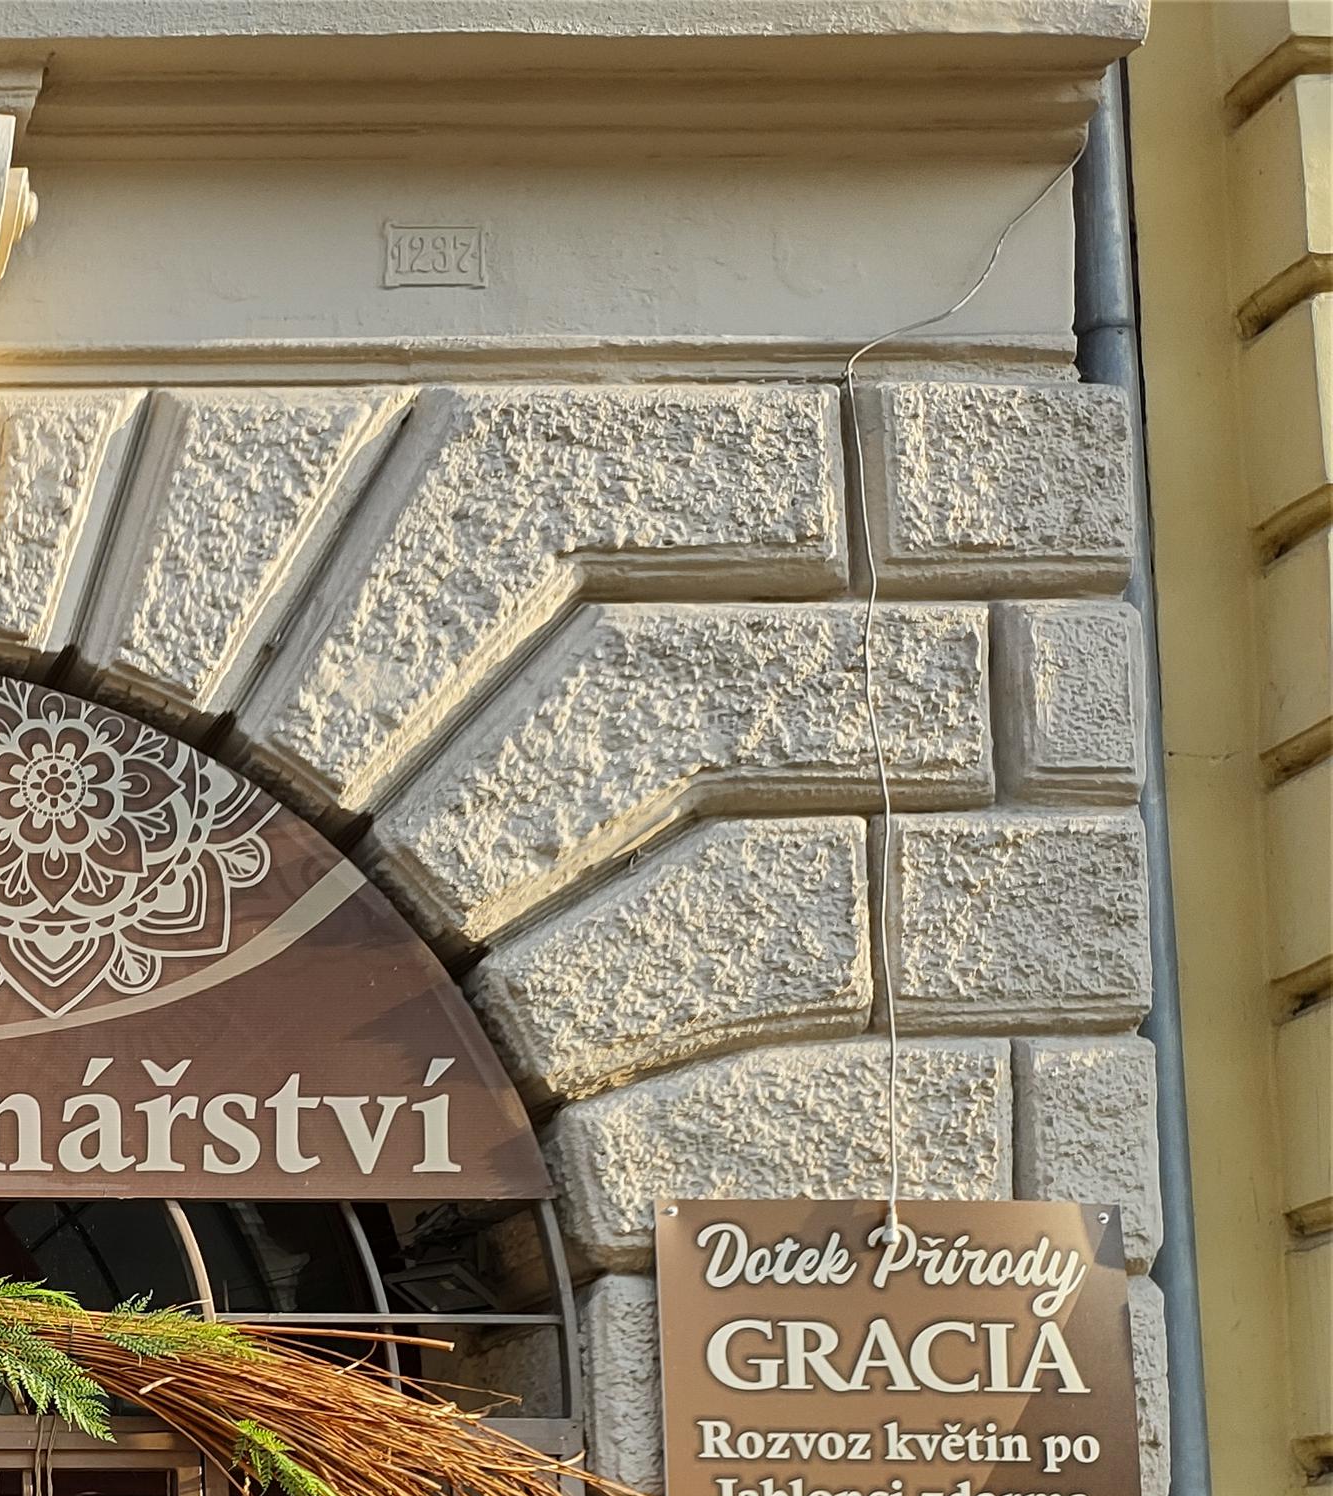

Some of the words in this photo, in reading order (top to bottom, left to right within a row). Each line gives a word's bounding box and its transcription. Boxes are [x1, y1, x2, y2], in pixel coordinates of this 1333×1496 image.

[697, 1222, 858, 1289] Dotek
[868, 1222, 1087, 1318] Přírody
[706, 1318, 1092, 1394] GRACIA
[697, 1419, 872, 1462] Rozvoz
[883, 1421, 1032, 1463] květin
[1042, 1434, 1101, 1473] po
